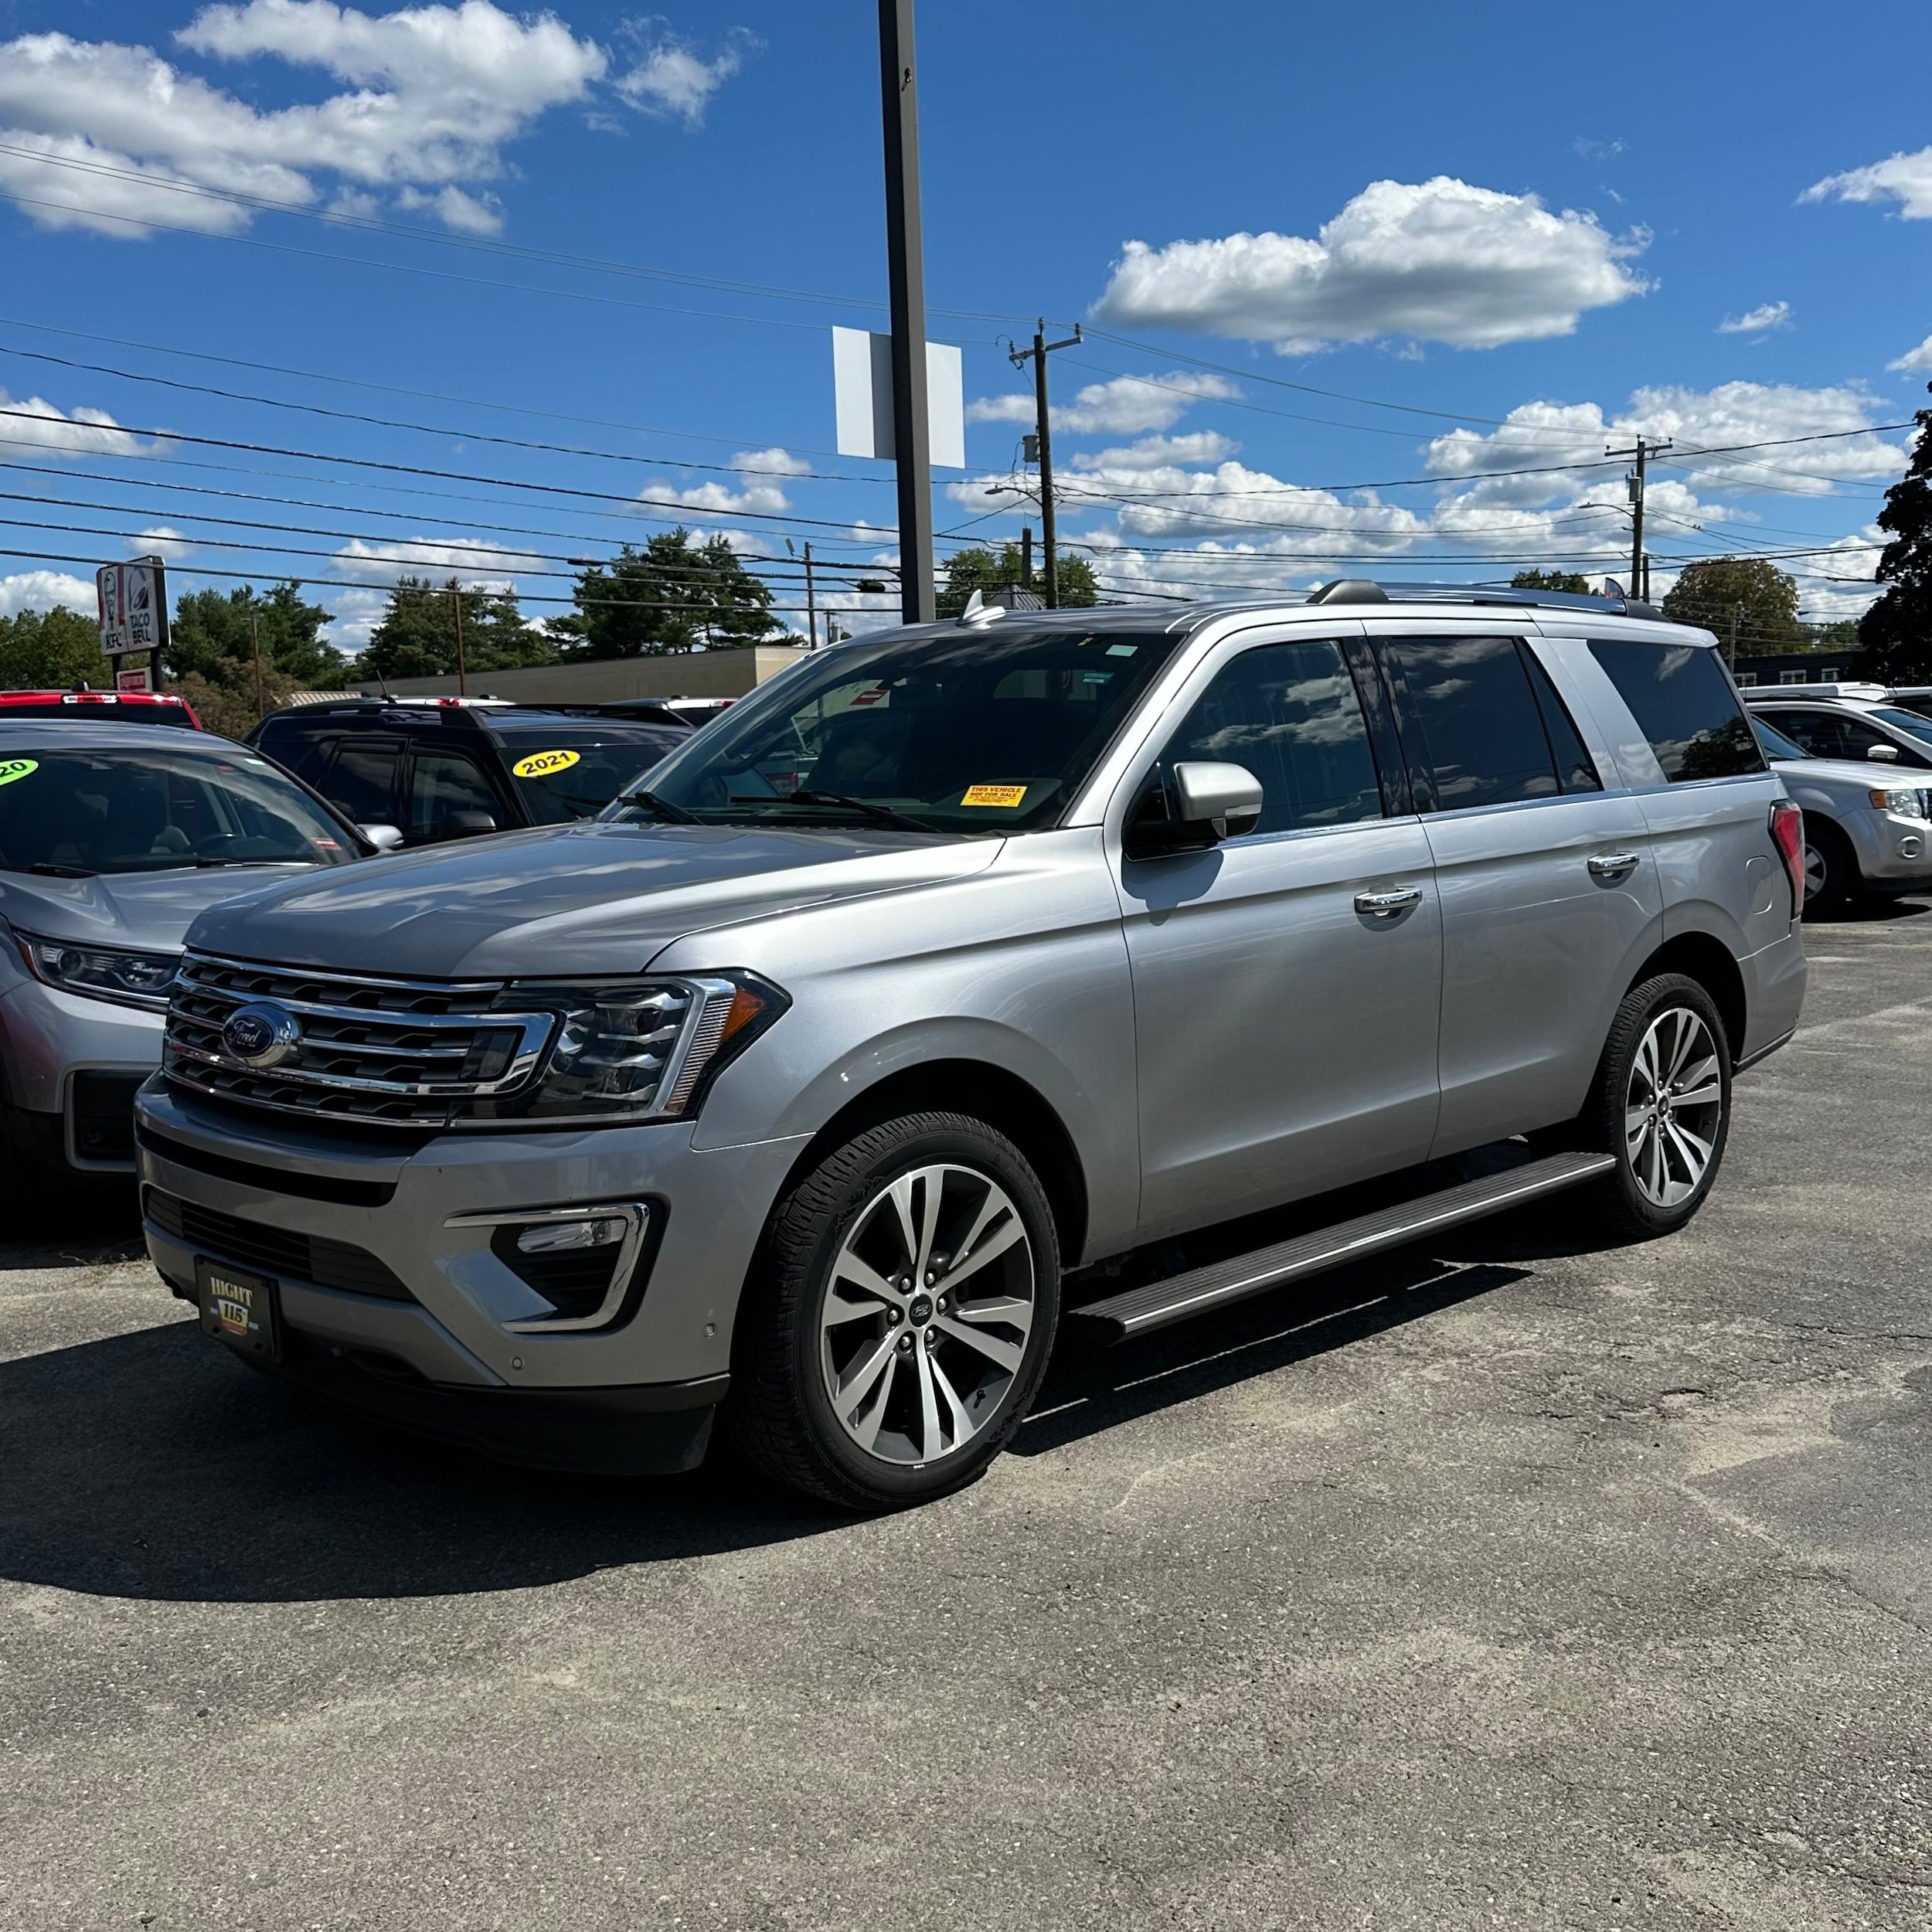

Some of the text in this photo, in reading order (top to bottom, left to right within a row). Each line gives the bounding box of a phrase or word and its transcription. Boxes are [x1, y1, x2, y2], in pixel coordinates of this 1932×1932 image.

[129, 612, 150, 629] TACO
[106, 632, 122, 649] KFC
[132, 628, 151, 645] BELL
[522, 752, 570, 774] 2021
[227, 1020, 261, 1043] Ford
[210, 1277, 253, 1308] HIGHT
